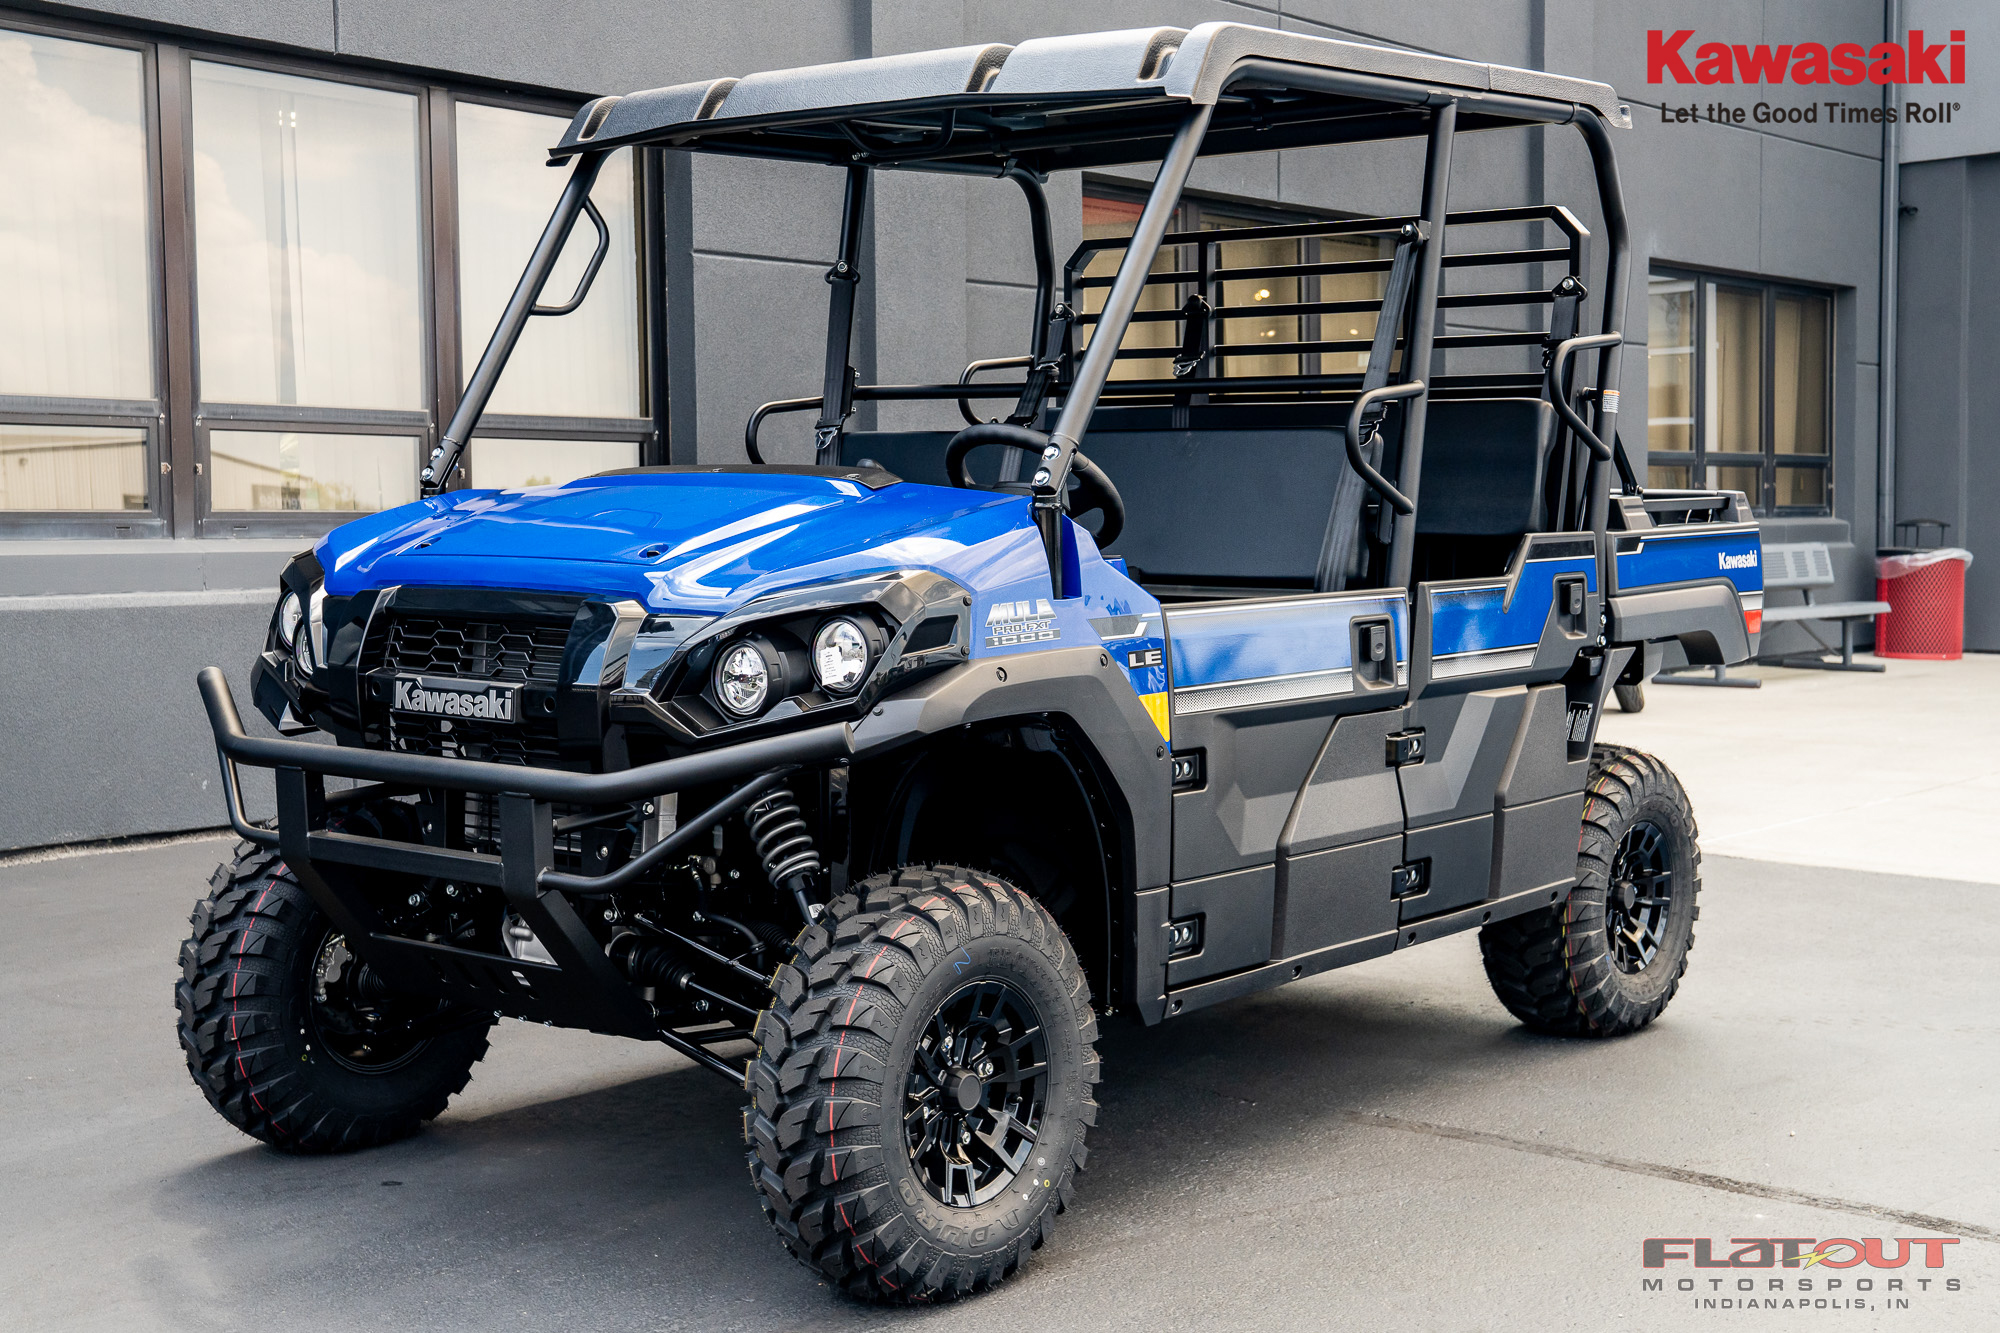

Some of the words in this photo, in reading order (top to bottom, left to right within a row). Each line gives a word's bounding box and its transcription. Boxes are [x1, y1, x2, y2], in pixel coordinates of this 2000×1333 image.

[1718, 550, 1757, 570] Kawasaki
[985, 598, 1057, 627] MULE
[992, 631, 1054, 647] 1000
[1129, 650, 1162, 668] LE
[394, 680, 512, 720] Kawasaki
